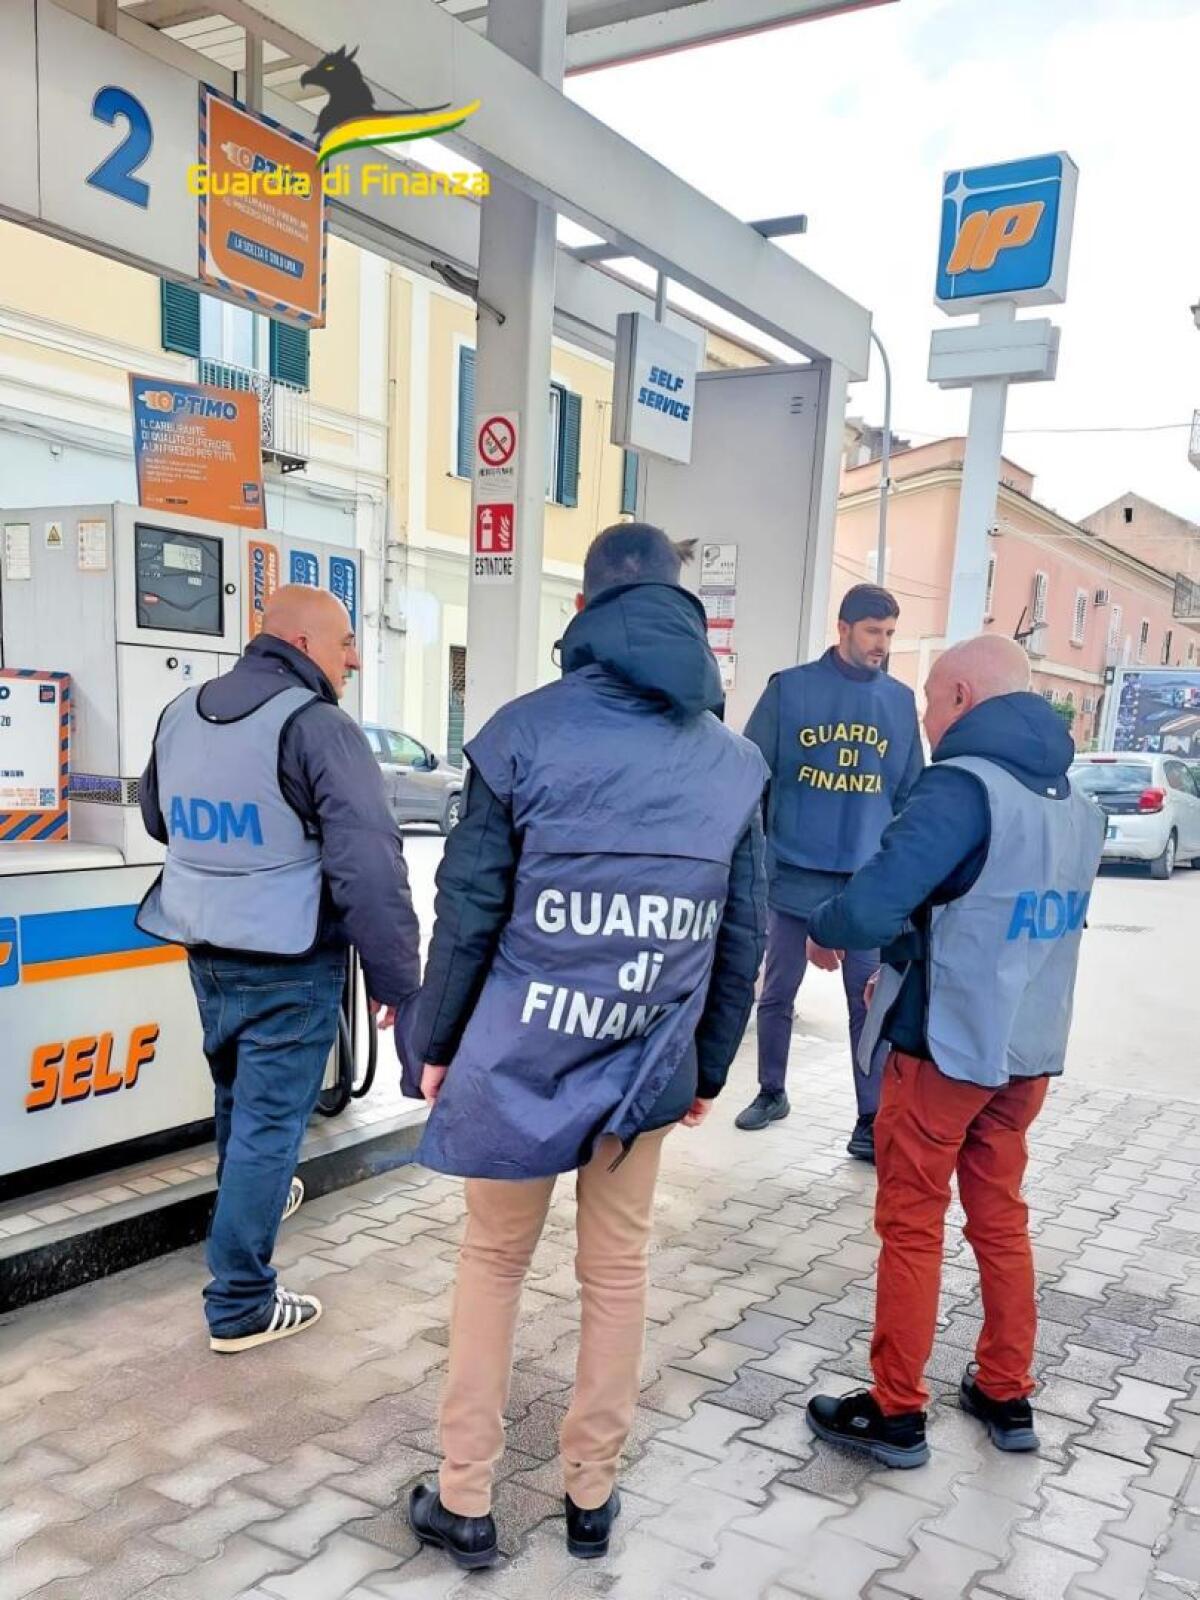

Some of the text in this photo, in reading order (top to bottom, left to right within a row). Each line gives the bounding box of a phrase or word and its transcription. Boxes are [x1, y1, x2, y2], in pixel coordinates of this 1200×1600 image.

[86, 86, 153, 209] 2
[946, 200, 1046, 275] IP
[637, 386, 691, 422] SERVICE
[648, 365, 684, 392] SELF
[157, 390, 239, 420] OPTIMO
[838, 748, 859, 767] DI
[170, 795, 264, 846] ADM
[535, 888, 718, 941] GUARDIA
[618, 951, 664, 993] di
[520, 981, 681, 1040] FINANZ
[24, 1023, 160, 1113] SELF
